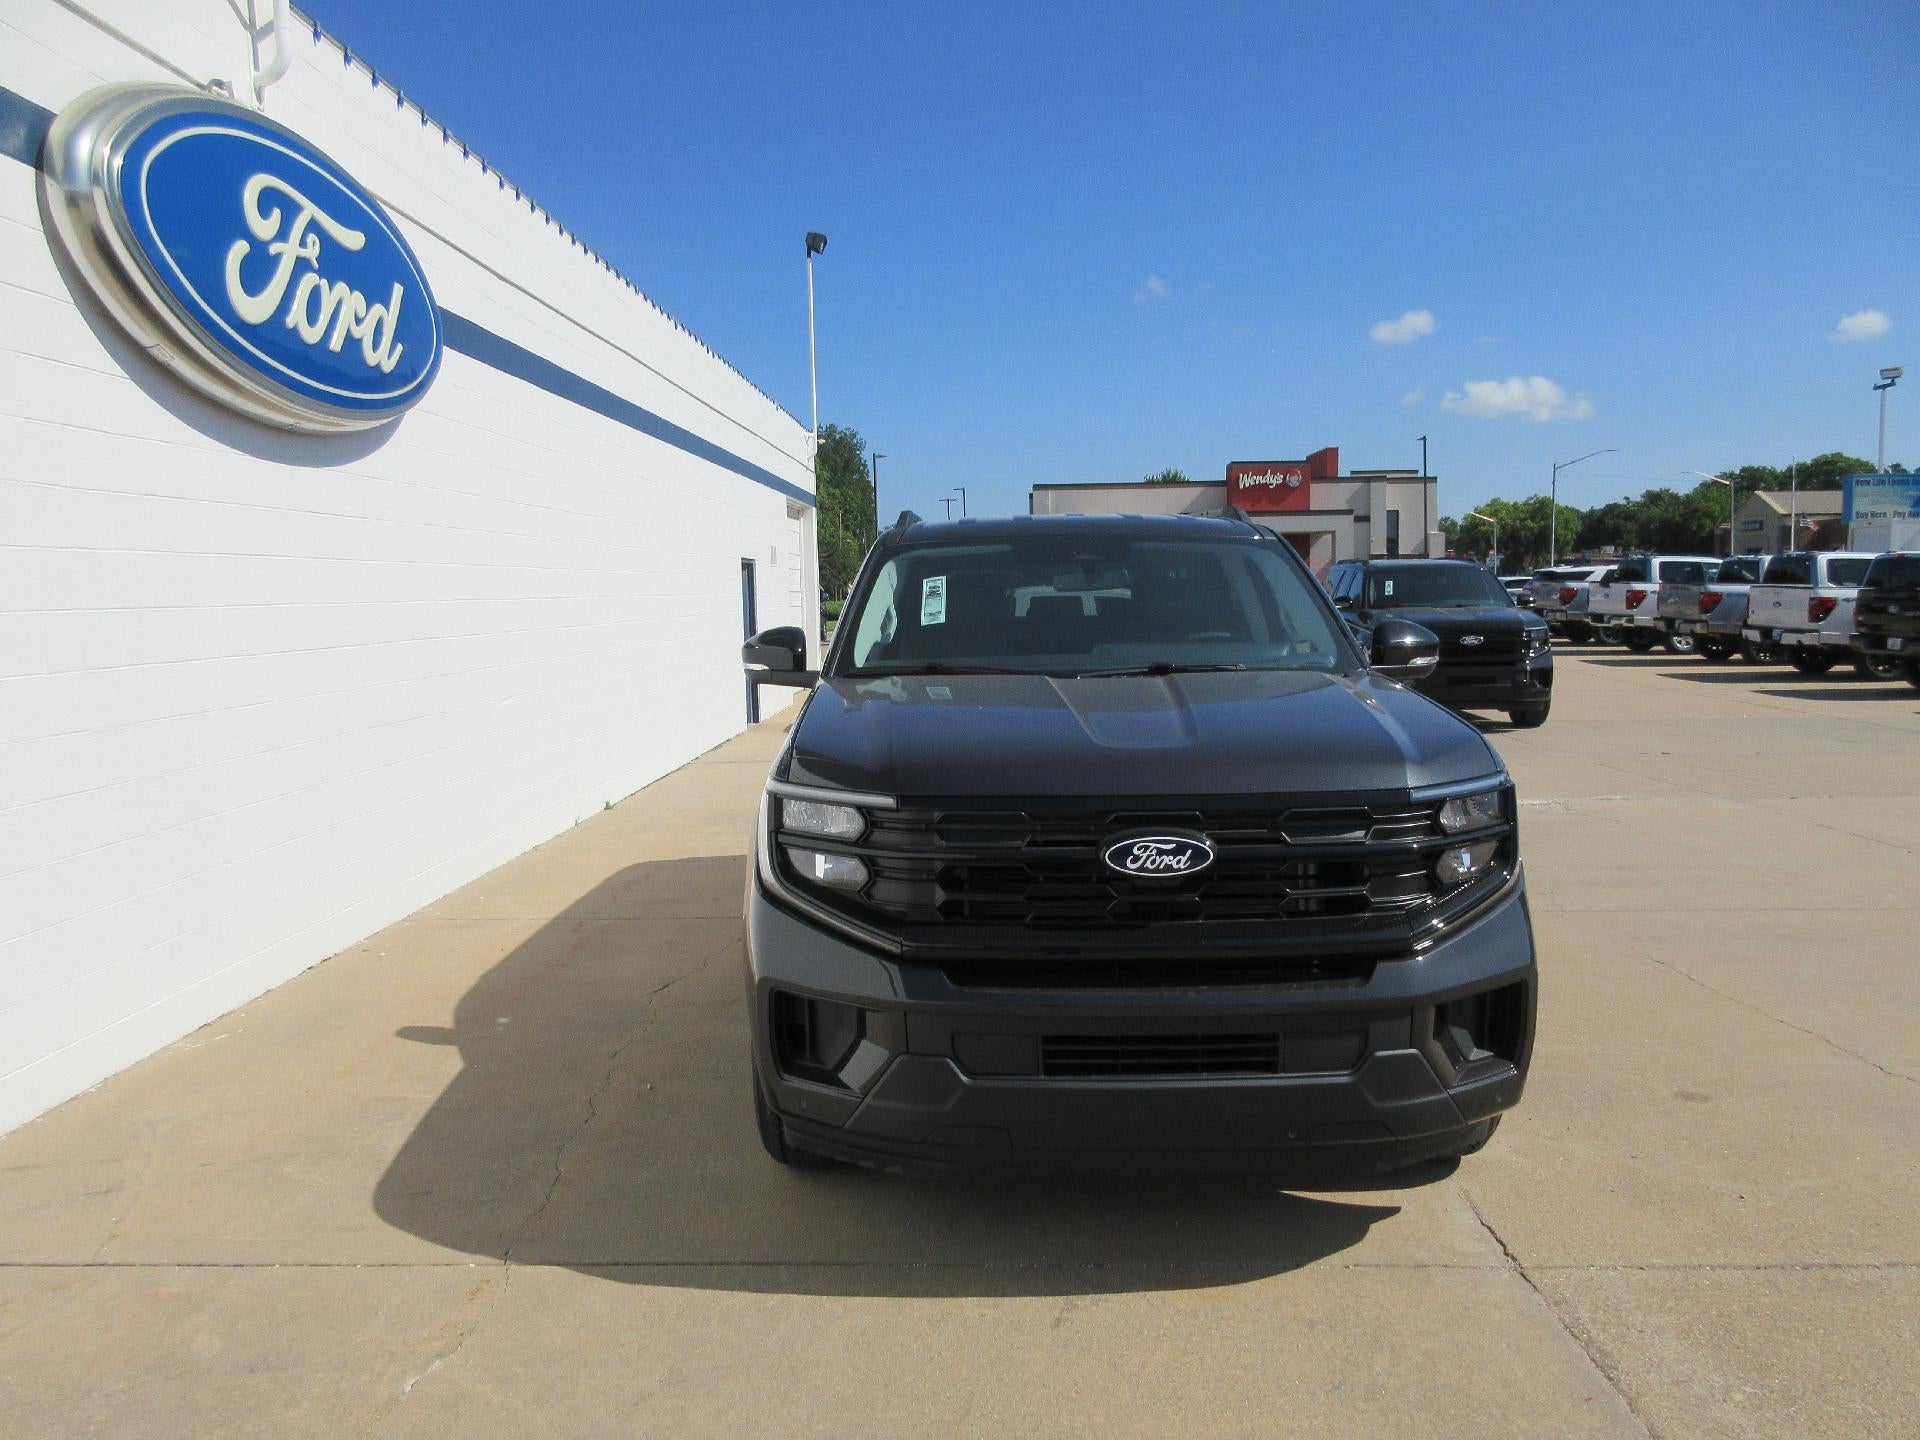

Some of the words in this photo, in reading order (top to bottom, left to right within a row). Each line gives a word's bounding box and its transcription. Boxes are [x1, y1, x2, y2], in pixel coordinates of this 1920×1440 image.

[225, 173, 404, 375] Ford
[1239, 469, 1284, 489] Wendy's
[1126, 842, 1193, 869] Ford
